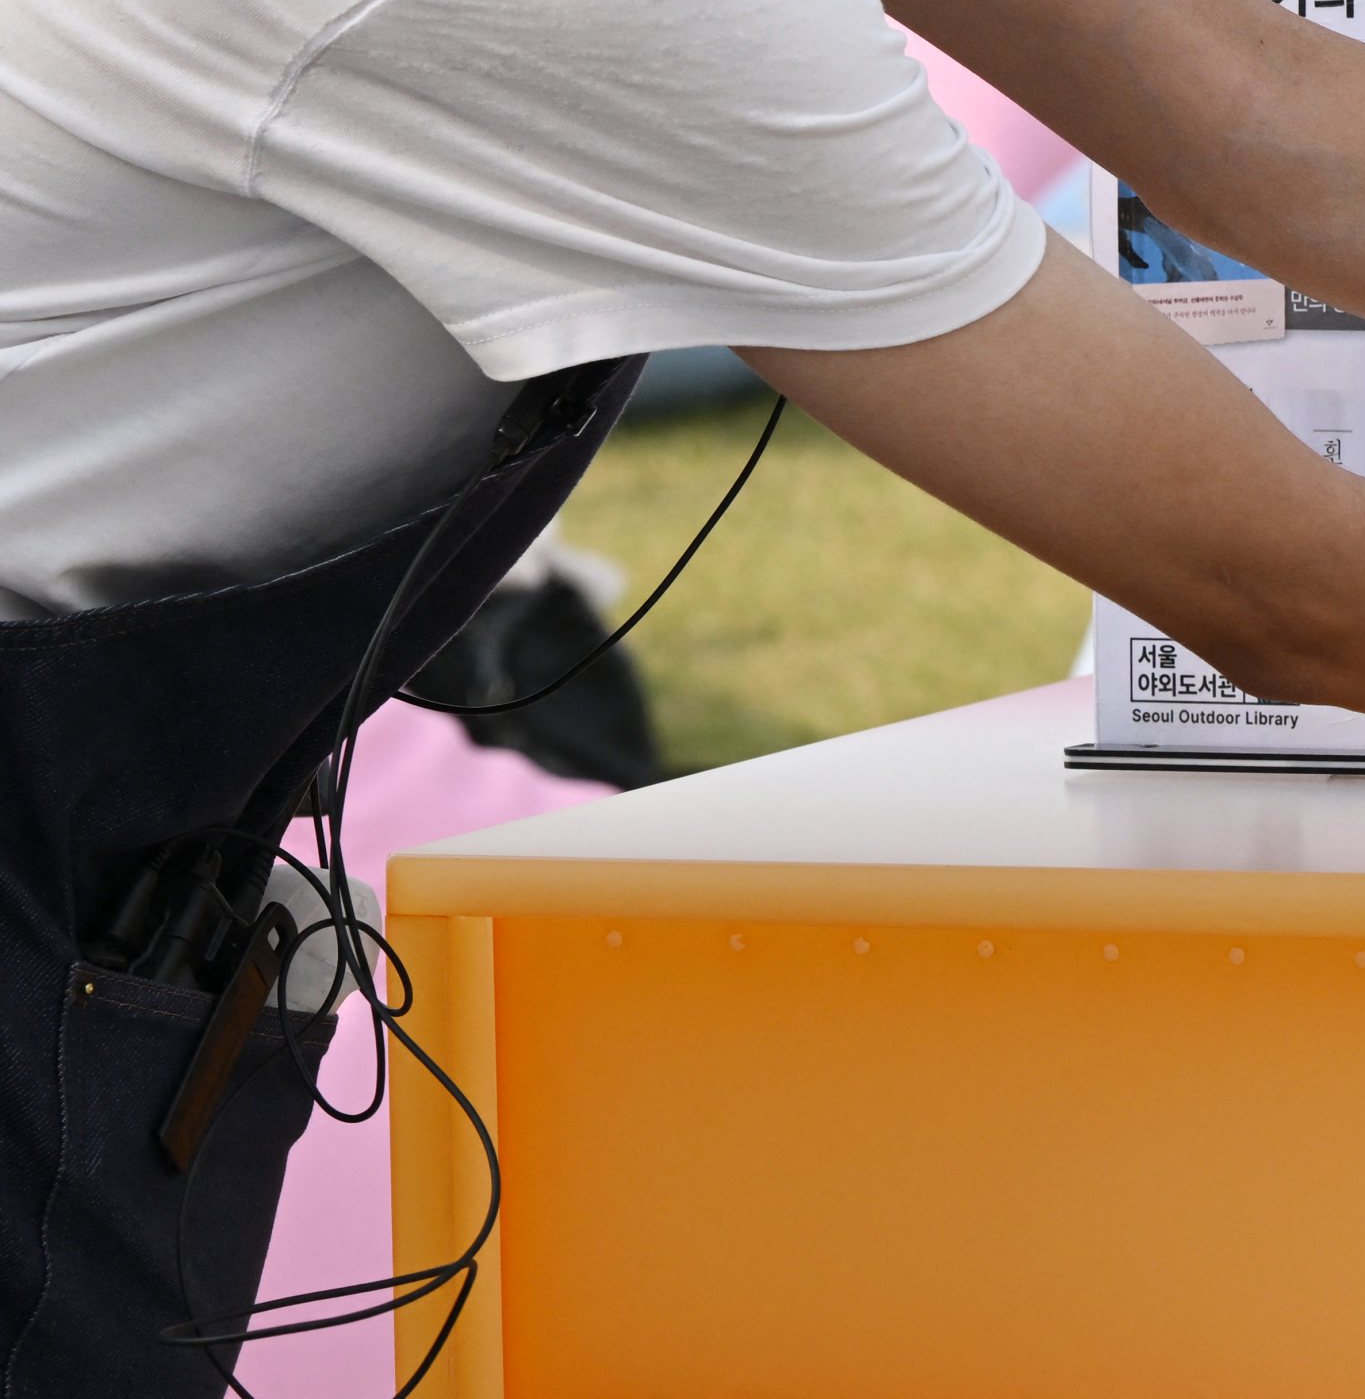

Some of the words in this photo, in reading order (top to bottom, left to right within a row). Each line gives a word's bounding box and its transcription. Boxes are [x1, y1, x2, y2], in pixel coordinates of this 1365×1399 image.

[1138, 644, 1177, 669] 서울
[1138, 672, 1237, 698] 야외도서관
[1132, 709, 1174, 723] Seoul
[1179, 710, 1241, 725] Outdoor
[1245, 711, 1299, 729] Library
